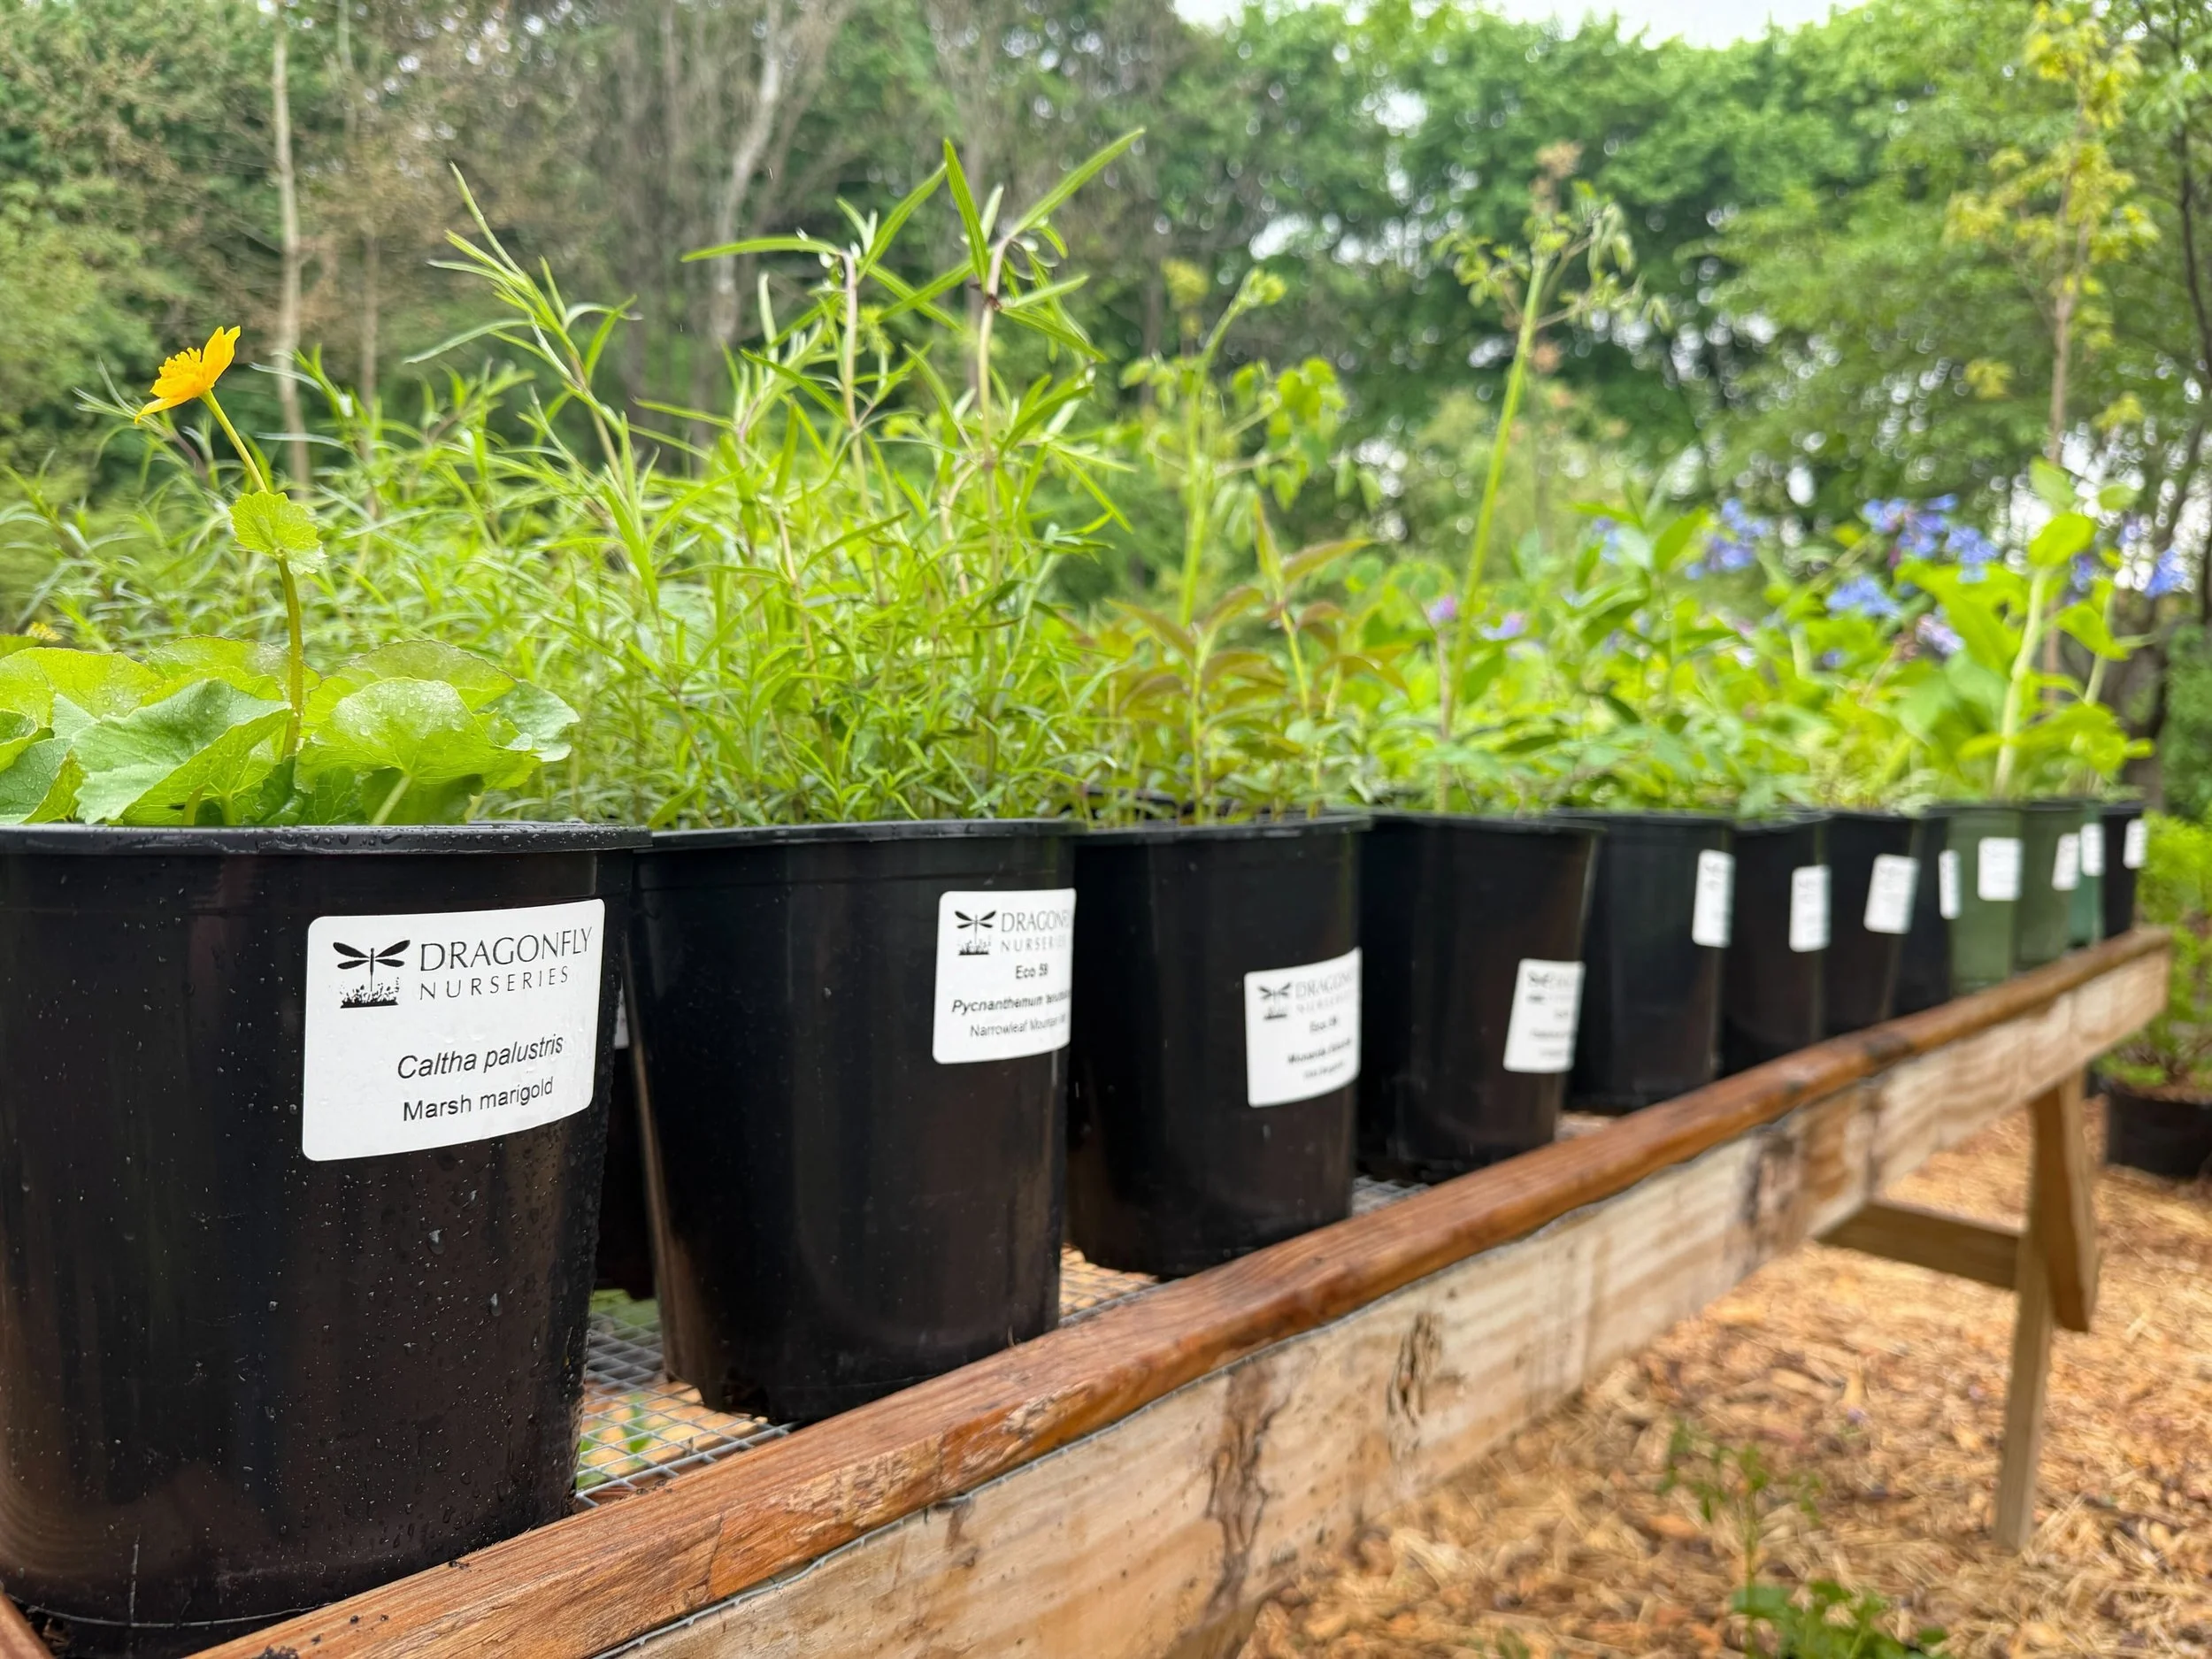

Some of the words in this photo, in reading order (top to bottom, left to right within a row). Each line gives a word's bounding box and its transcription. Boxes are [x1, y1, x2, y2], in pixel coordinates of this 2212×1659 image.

[1001, 909, 1070, 933] DRAGON
[419, 926, 593, 972] DRAGONFLY
[419, 965, 569, 1001] NURSERIES
[1015, 964, 1036, 979] Eco
[970, 1019, 1028, 1037] Narrowleaf
[397, 1050, 477, 1079] Caltha
[483, 1033, 564, 1073] palustris
[403, 1094, 472, 1121] Marsh
[480, 1077, 554, 1110] marigold
